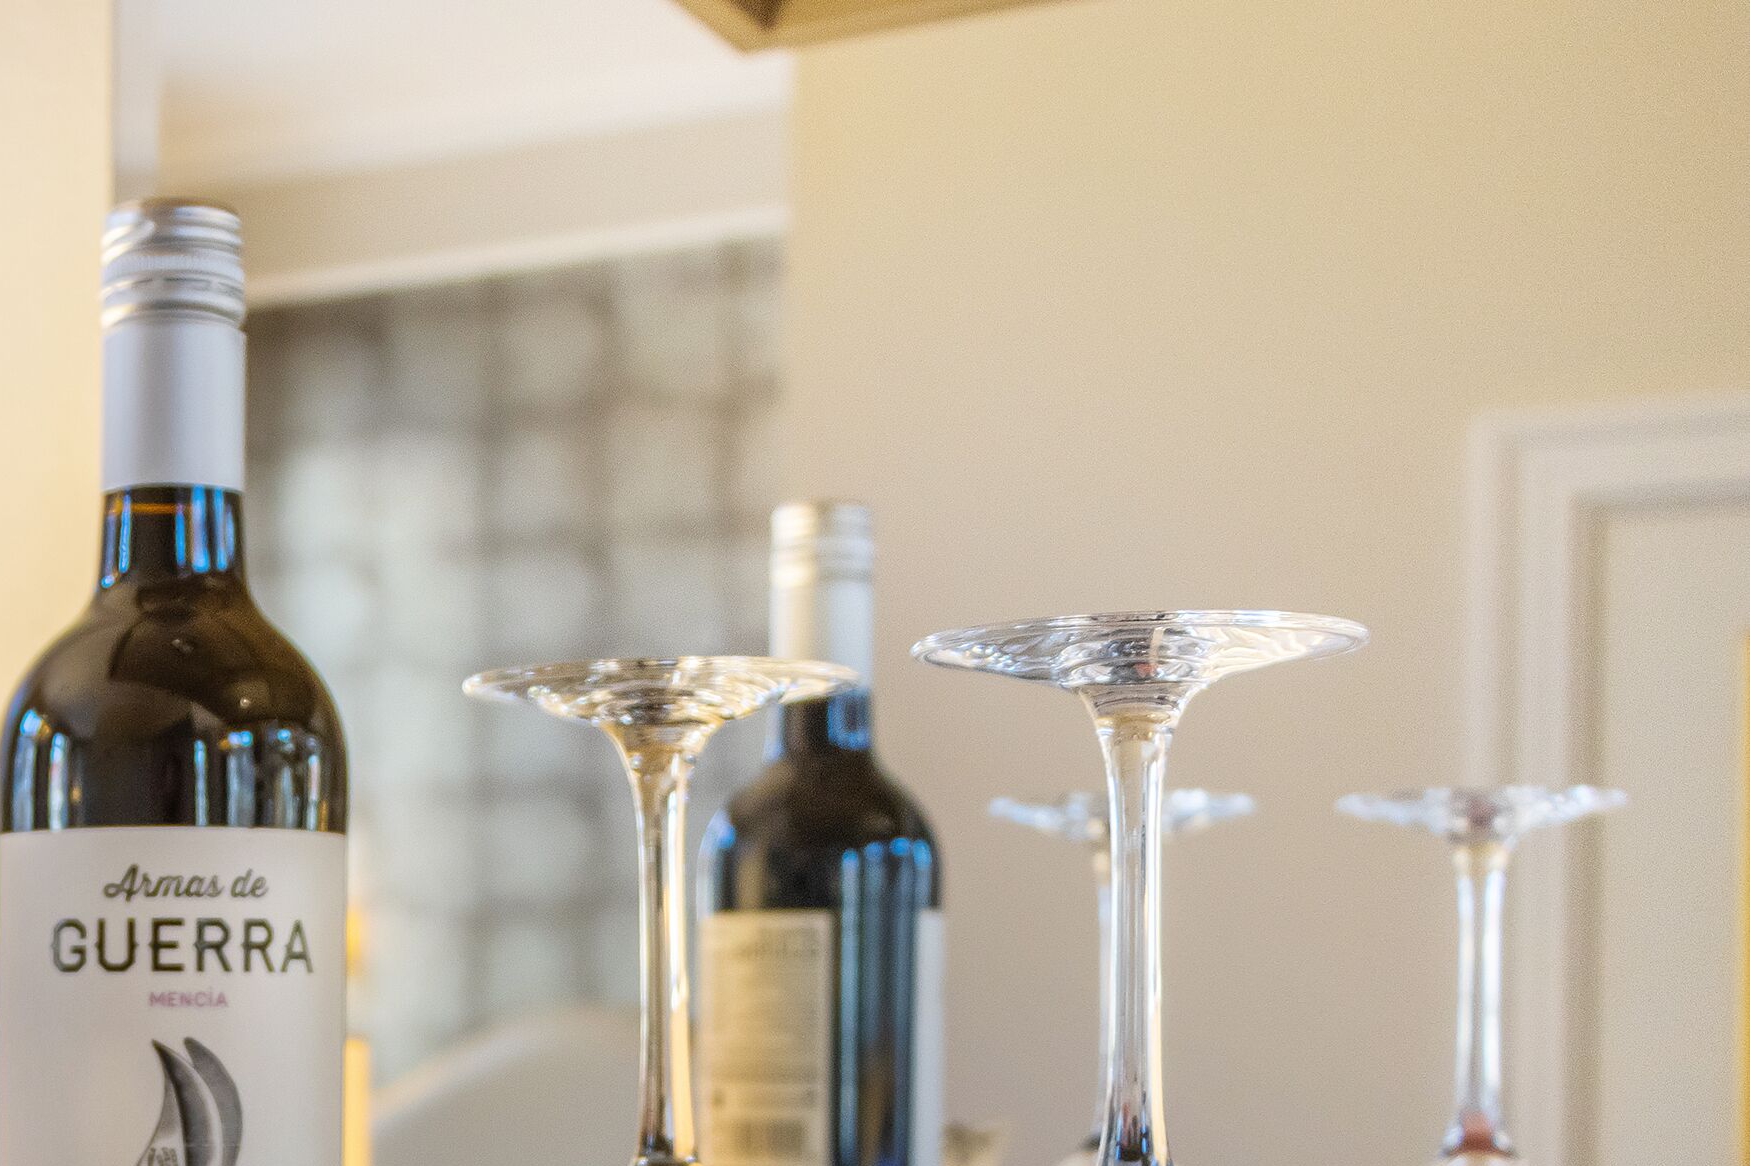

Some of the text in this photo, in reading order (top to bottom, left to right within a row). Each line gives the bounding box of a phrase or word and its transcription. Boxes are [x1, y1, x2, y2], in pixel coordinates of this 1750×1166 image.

[104, 864, 268, 902] Armas de
[51, 917, 314, 973] GUERRA
